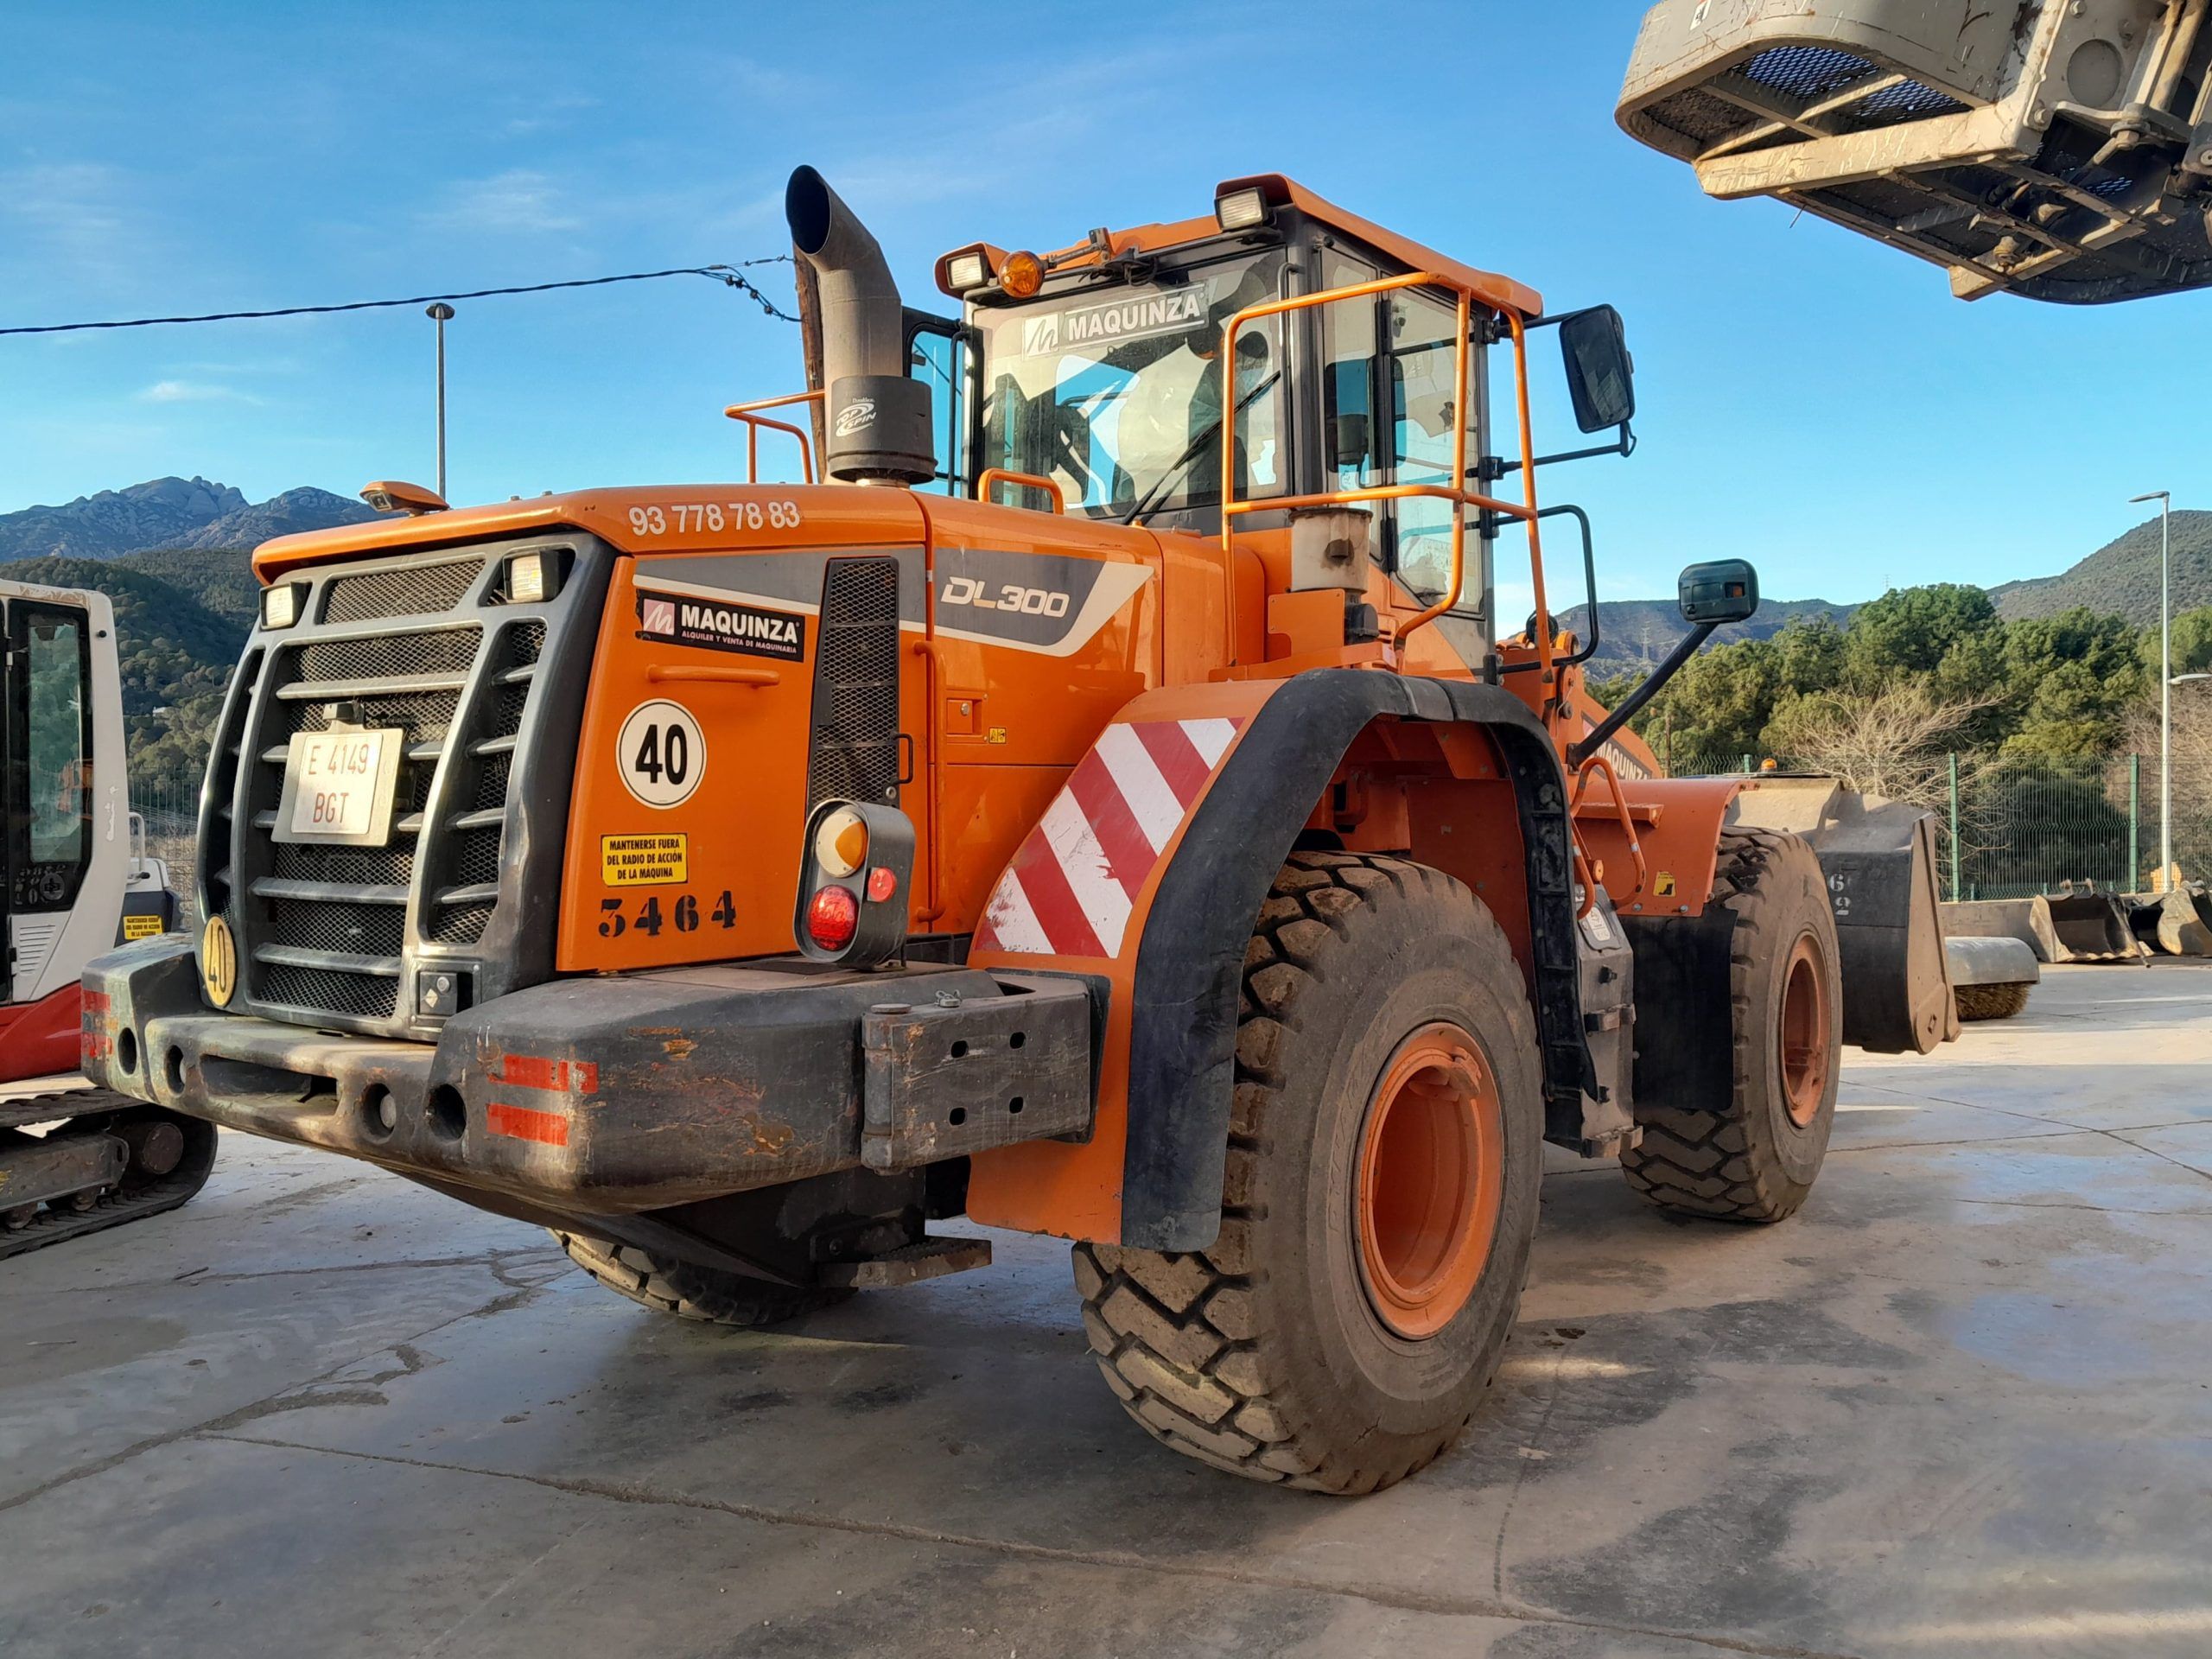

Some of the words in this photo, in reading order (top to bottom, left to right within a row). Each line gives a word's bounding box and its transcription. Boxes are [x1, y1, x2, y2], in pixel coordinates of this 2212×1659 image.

[1068, 293, 1201, 342] MAQUINZA
[836, 409, 859, 427] TOP
[847, 411, 877, 429] SPIN
[628, 506, 666, 536] 93
[671, 504, 725, 532] 778
[728, 502, 764, 530] 78
[767, 501, 800, 529] 83
[941, 576, 1070, 618] DL300
[681, 604, 798, 644] MAQUINZA
[682, 631, 714, 642] ALQUILER
[722, 637, 744, 646] VENTA
[746, 639, 753, 647] DE
[755, 641, 797, 654] MAQUINARIA
[308, 745, 321, 775] E
[327, 743, 370, 775] 4149
[635, 724, 687, 785] 40
[1596, 741, 1648, 780] MAQUINZ
[313, 792, 349, 823] BGT
[607, 855, 620, 866] DEL
[622, 855, 645, 865] RADIO
[647, 854, 656, 864] DE
[658, 850, 683, 863] ACCIÓN
[609, 839, 656, 851] MANTENERSE
[658, 838, 680, 849] FUERA
[618, 869, 626, 880] DE
[629, 869, 638, 880] LA
[639, 866, 673, 879] MÁQUINA
[598, 890, 737, 938] 3464
[208, 923, 227, 993] 40
